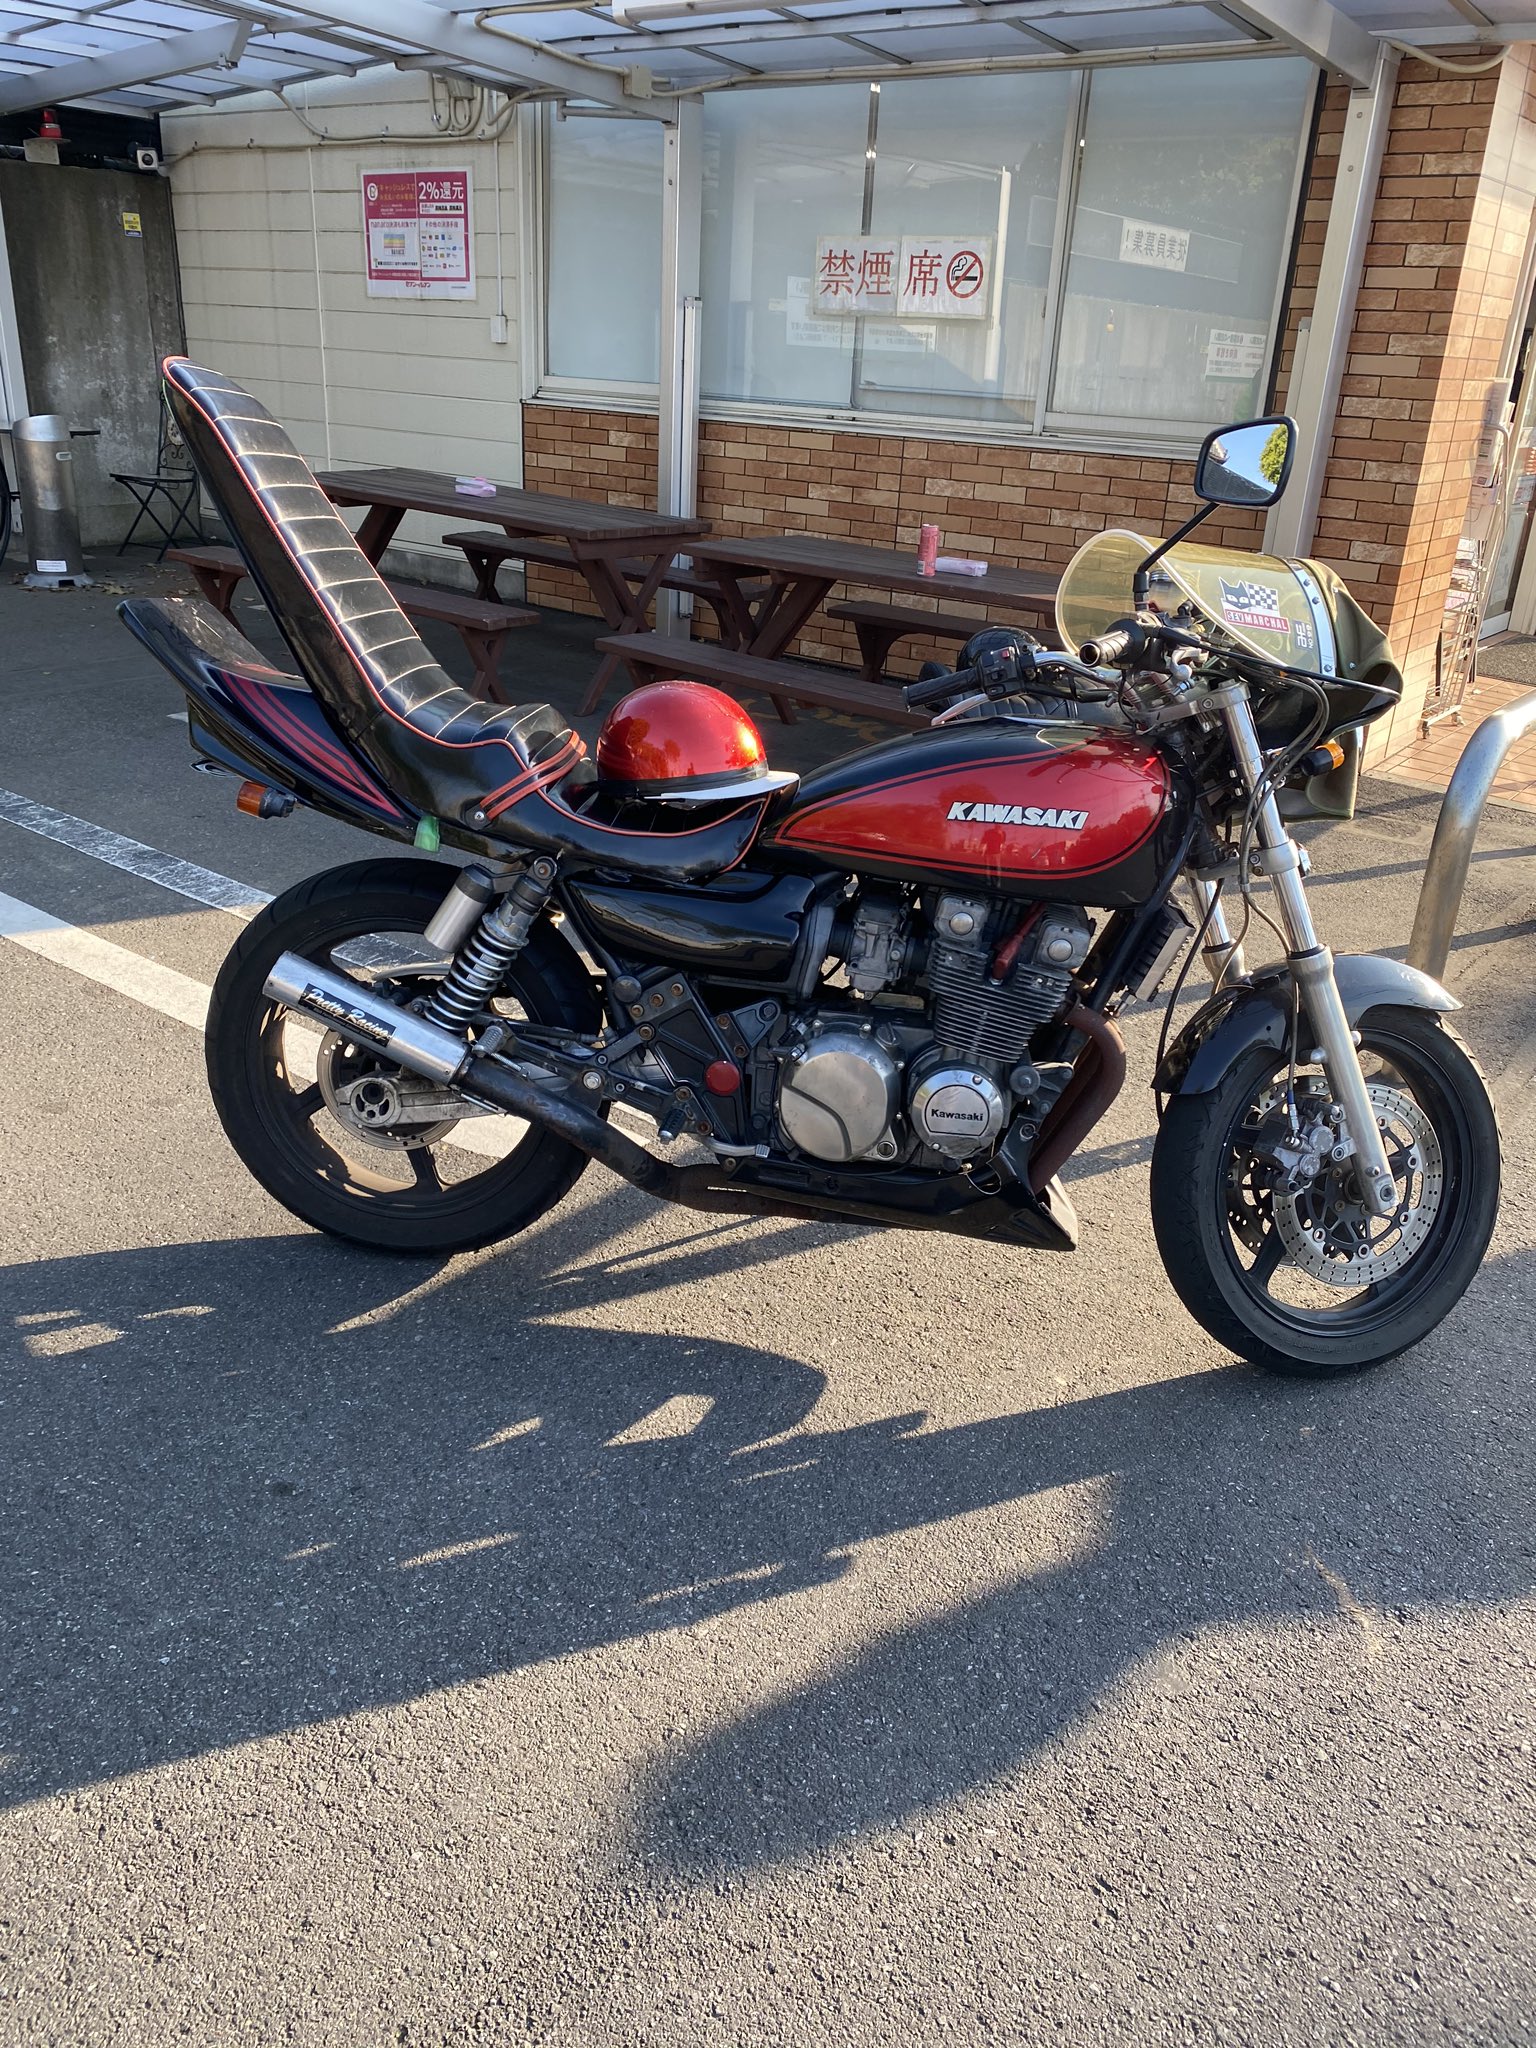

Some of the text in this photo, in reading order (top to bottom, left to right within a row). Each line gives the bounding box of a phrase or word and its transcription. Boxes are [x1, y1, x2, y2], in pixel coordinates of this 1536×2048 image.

[418, 181, 464, 200] 2%還元
[819, 249, 942, 297] 禁煙席
[1245, 613, 1288, 630] MARCHAL
[947, 801, 1089, 830] KAWASAKI
[304, 988, 389, 1041] Pretty Racing
[931, 1108, 984, 1122] Kawasaki
